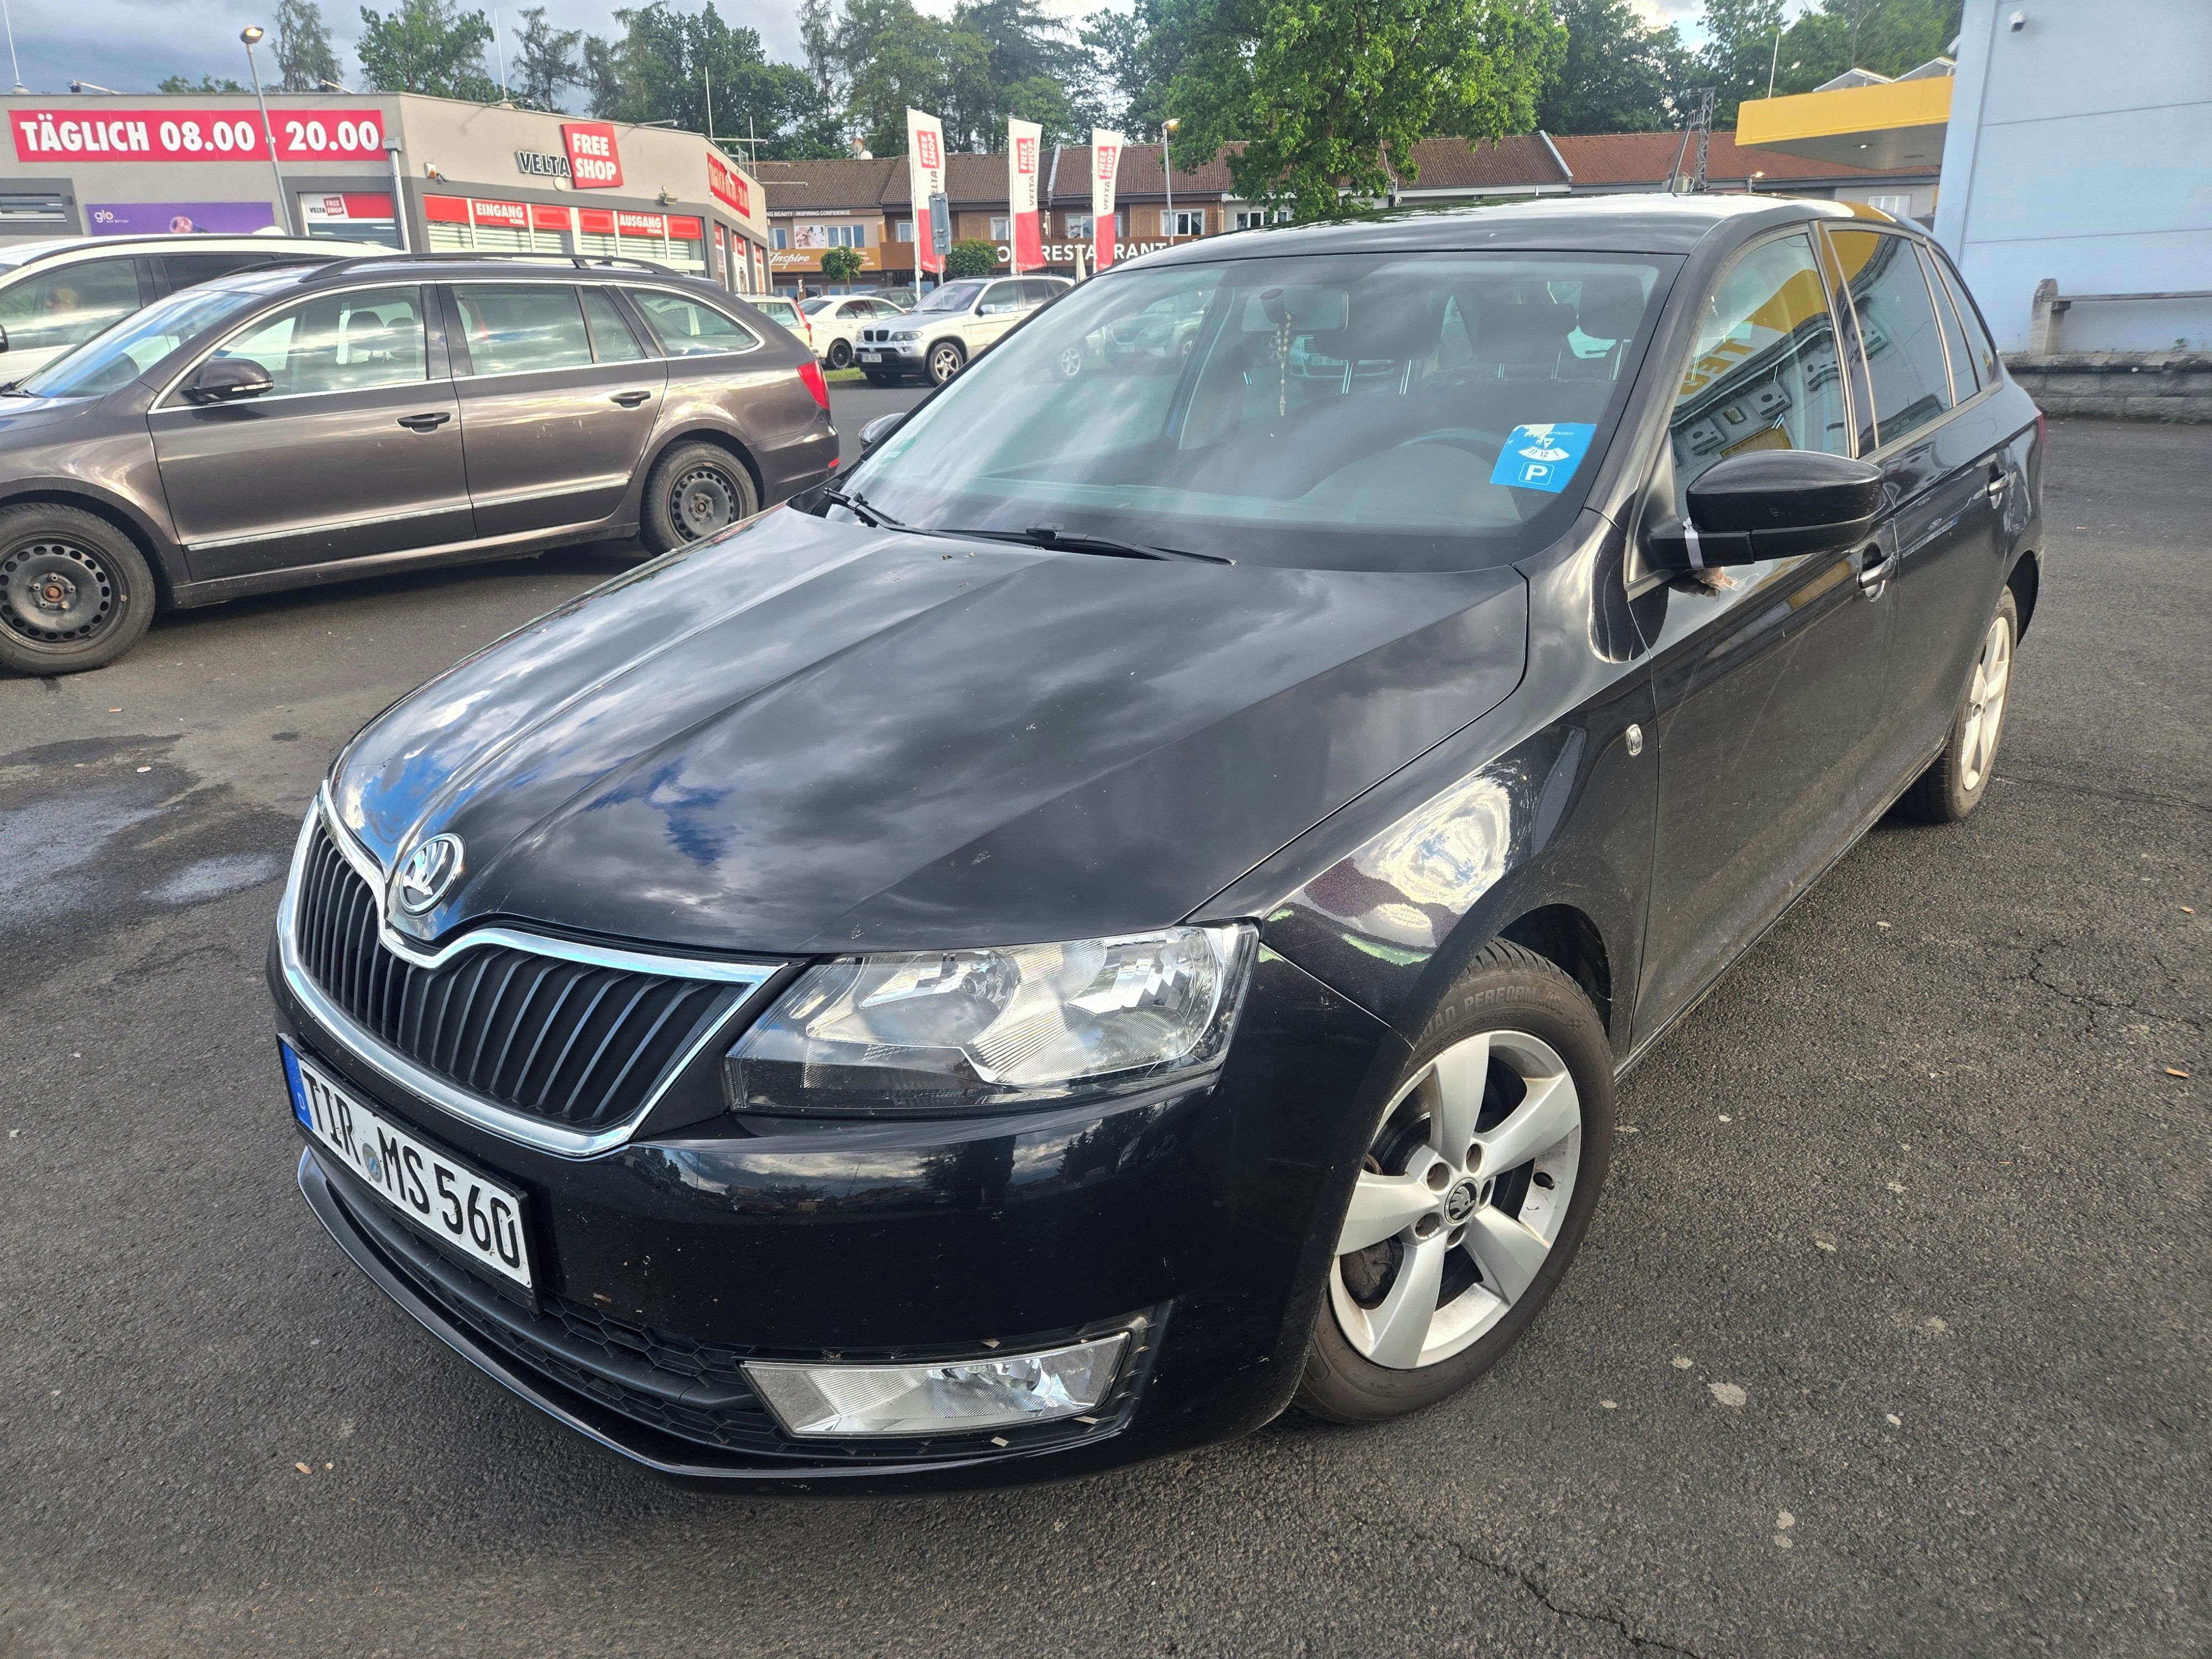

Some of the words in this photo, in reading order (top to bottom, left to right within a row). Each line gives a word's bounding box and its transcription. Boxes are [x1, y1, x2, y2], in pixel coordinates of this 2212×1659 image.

[19, 113, 150, 151] TÄGLICH
[160, 121, 255, 151] 08.00
[285, 121, 379, 151] 20.00
[572, 133, 609, 156] FREE
[921, 135, 929, 164] FREE
[927, 133, 937, 167] SHOP
[1020, 142, 1028, 170] FREE
[518, 150, 572, 177] VELTA
[575, 158, 617, 181] SHOP
[1105, 148, 1115, 178] SHOP
[95, 210, 113, 223] glo
[476, 203, 524, 218] EINGANG
[619, 213, 662, 228] AUSGANG
[1041, 243, 1167, 261] RESTARANT
[1525, 464, 1548, 481] P
[1463, 985, 1568, 1016] PERFORMANCE
[297, 1092, 306, 1110] D
[301, 1067, 361, 1166] TIR
[377, 1126, 430, 1215] MS
[433, 1162, 521, 1270] 560
